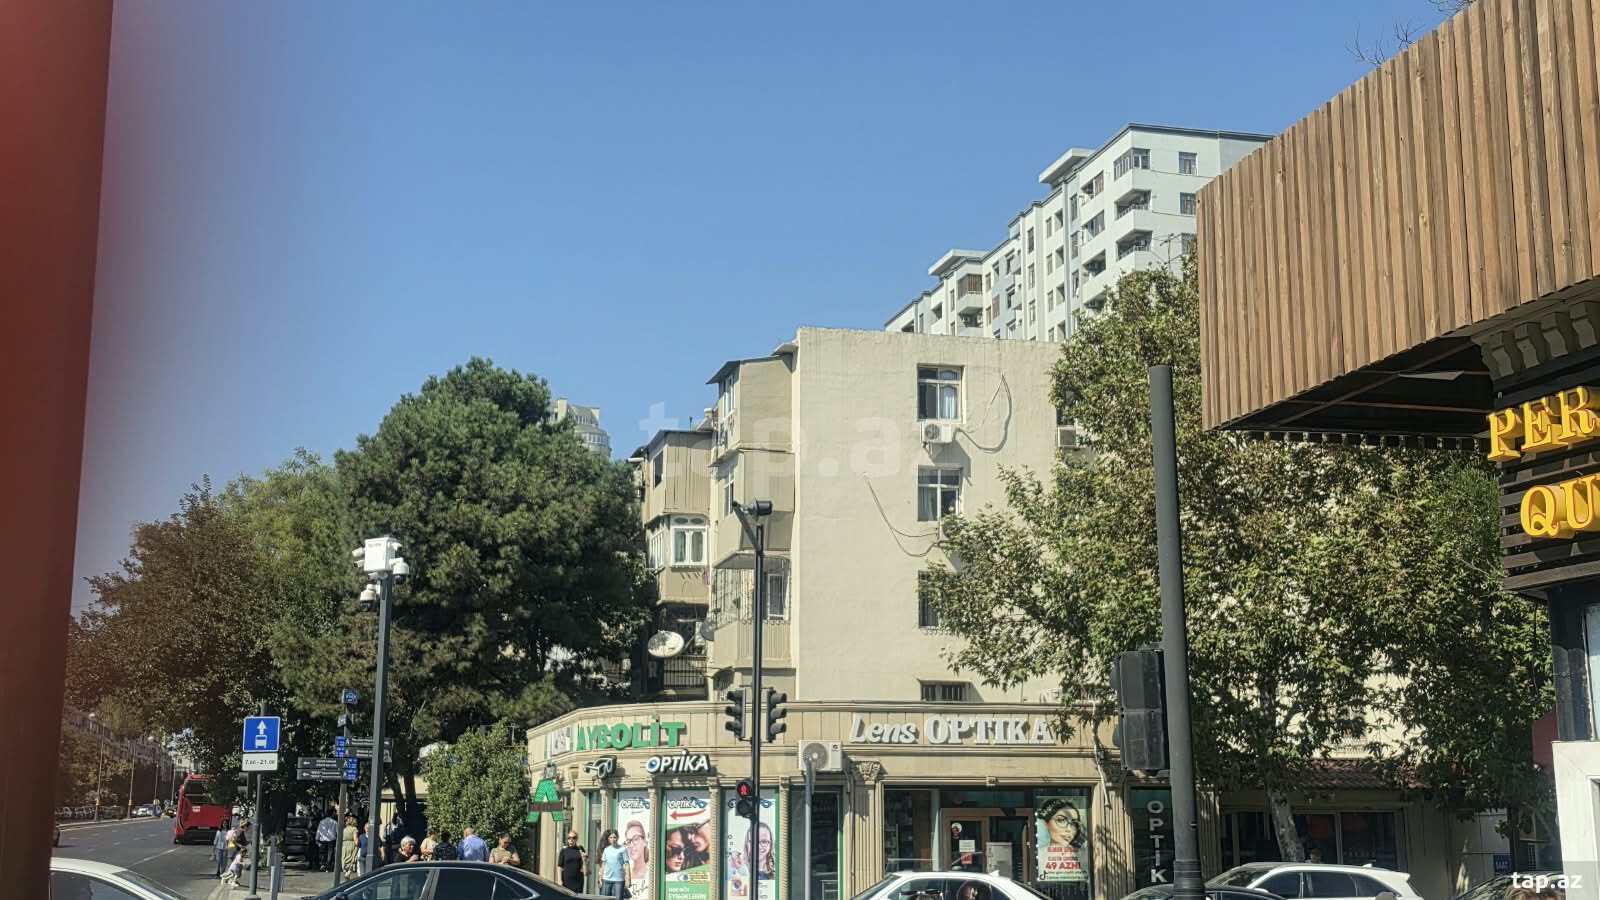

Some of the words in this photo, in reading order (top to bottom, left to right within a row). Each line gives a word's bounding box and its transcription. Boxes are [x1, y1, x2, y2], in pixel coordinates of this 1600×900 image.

[1487, 386, 1596, 461] PER
[1520, 475, 1597, 536] QU
[850, 715, 919, 744] Lens
[925, 714, 1056, 745] OPTIKA
